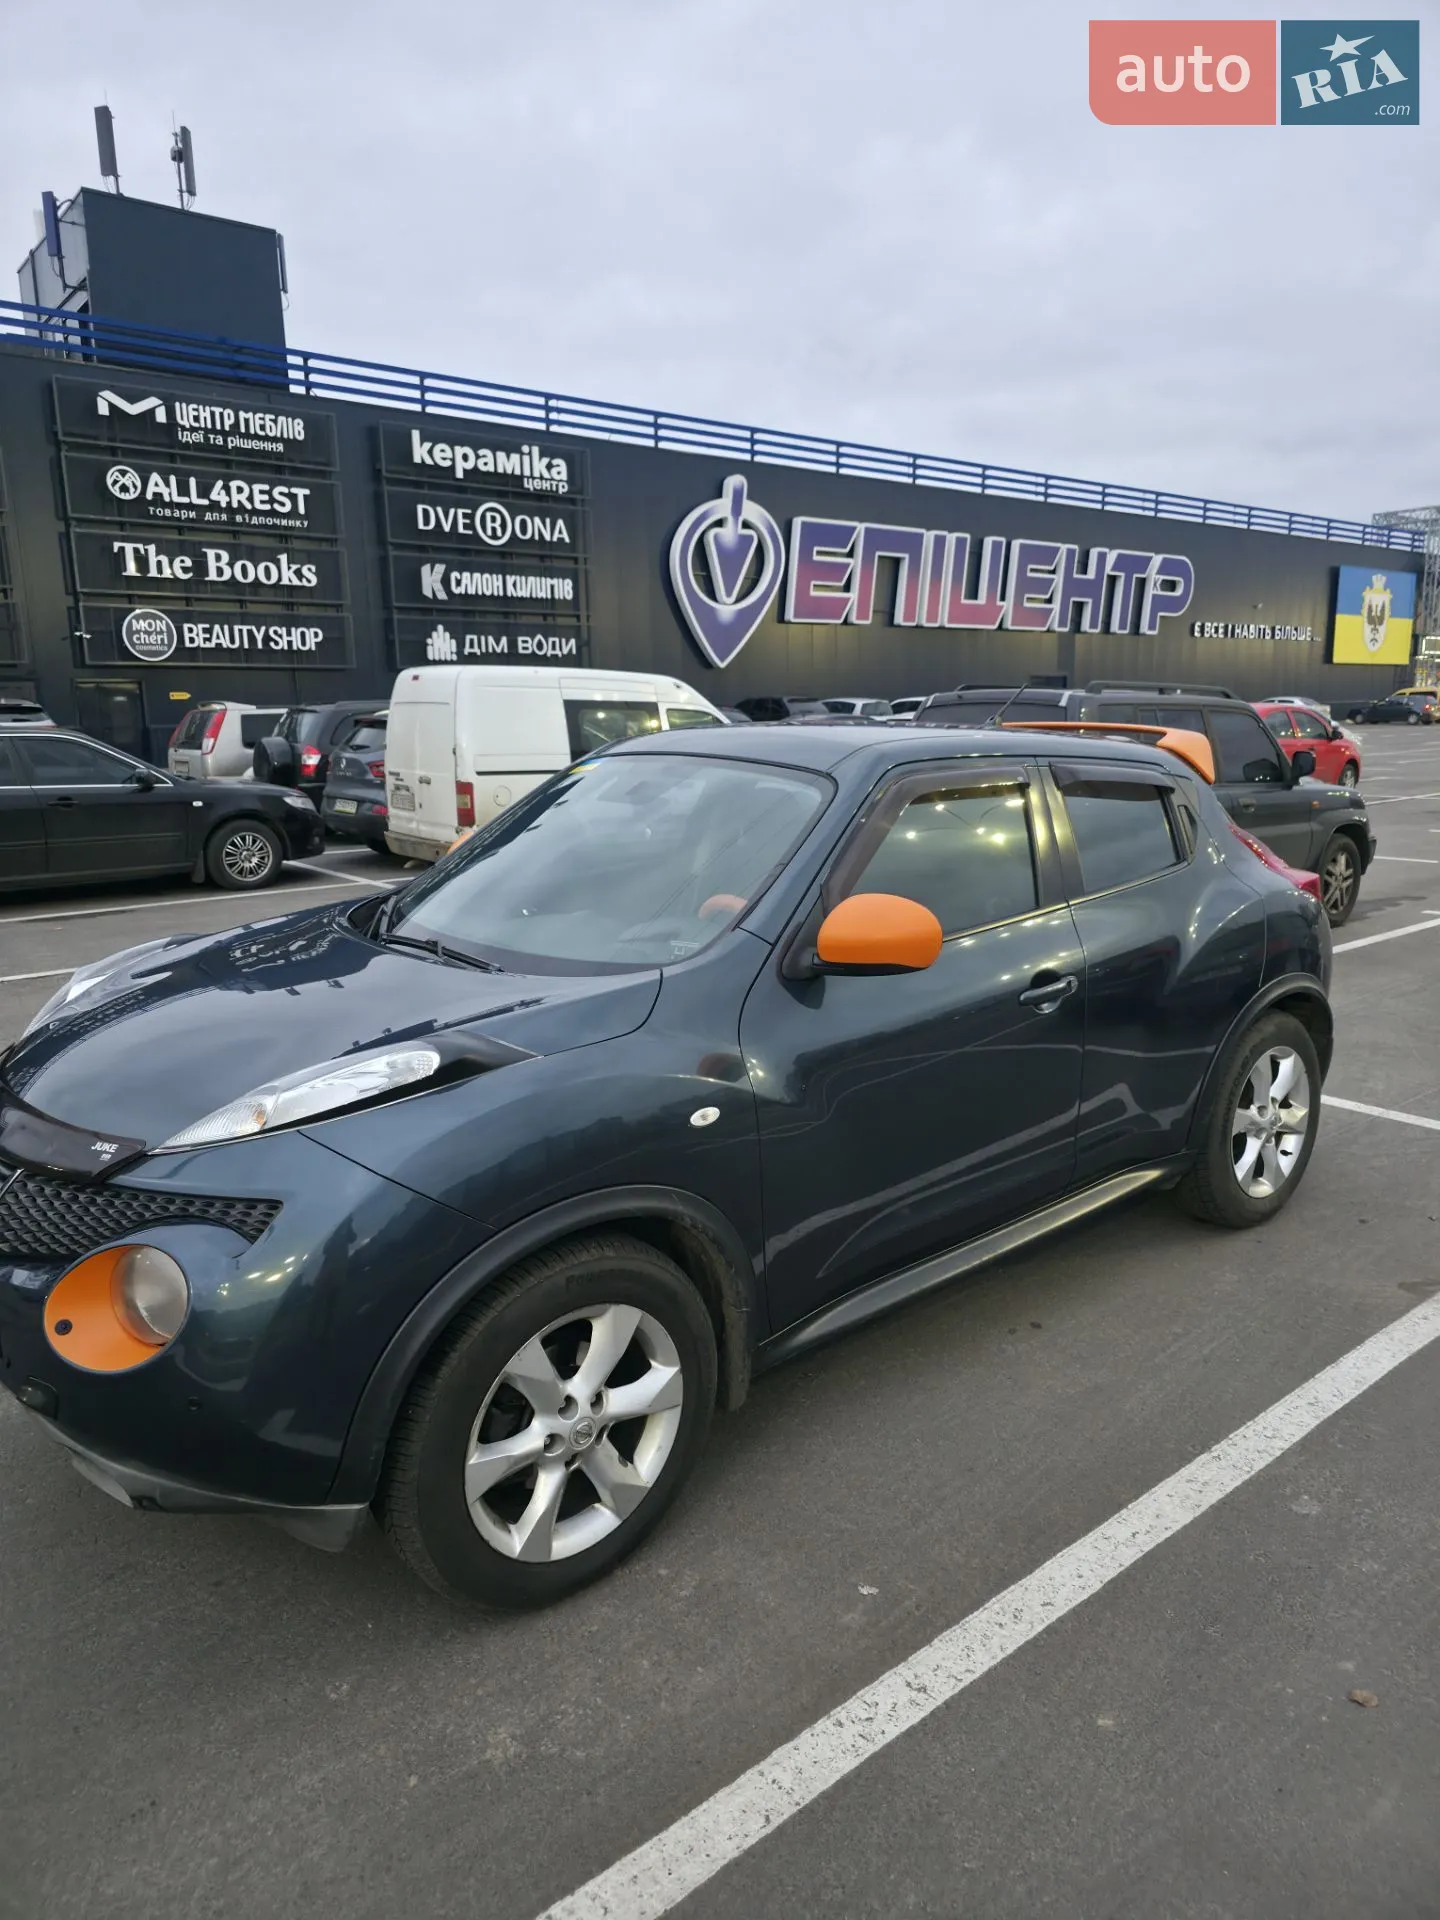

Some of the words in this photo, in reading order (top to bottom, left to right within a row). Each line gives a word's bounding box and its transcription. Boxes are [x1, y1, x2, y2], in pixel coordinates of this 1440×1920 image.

[175, 402, 235, 431] ЦЕНТР
[239, 410, 305, 440] МЕБЛІВ
[178, 428, 204, 443] ідеї
[208, 433, 223, 446] та
[228, 435, 284, 452] рішення
[146, 472, 310, 514] ALL4REST
[523, 478, 568, 494] центр
[148, 506, 196, 520] товари
[236, 514, 309, 528] відпочинку
[113, 541, 193, 579] The
[201, 547, 318, 587] Books
[784, 516, 1194, 635] ЕПІЦЕНТР
[450, 571, 503, 597] САЛОН
[506, 575, 573, 600] КИЛИМІВ
[131, 618, 167, 632] MON
[183, 623, 266, 649] BEAUTY
[269, 626, 323, 651] SHOP
[1204, 622, 1225, 639] ВСЕ
[1234, 623, 1272, 640] НАВІТЬ
[132, 631, 168, 645] chéri
[463, 634, 508, 656] ДІМ
[517, 633, 577, 658] ВОДИ
[91, 1141, 119, 1153] JUKE
